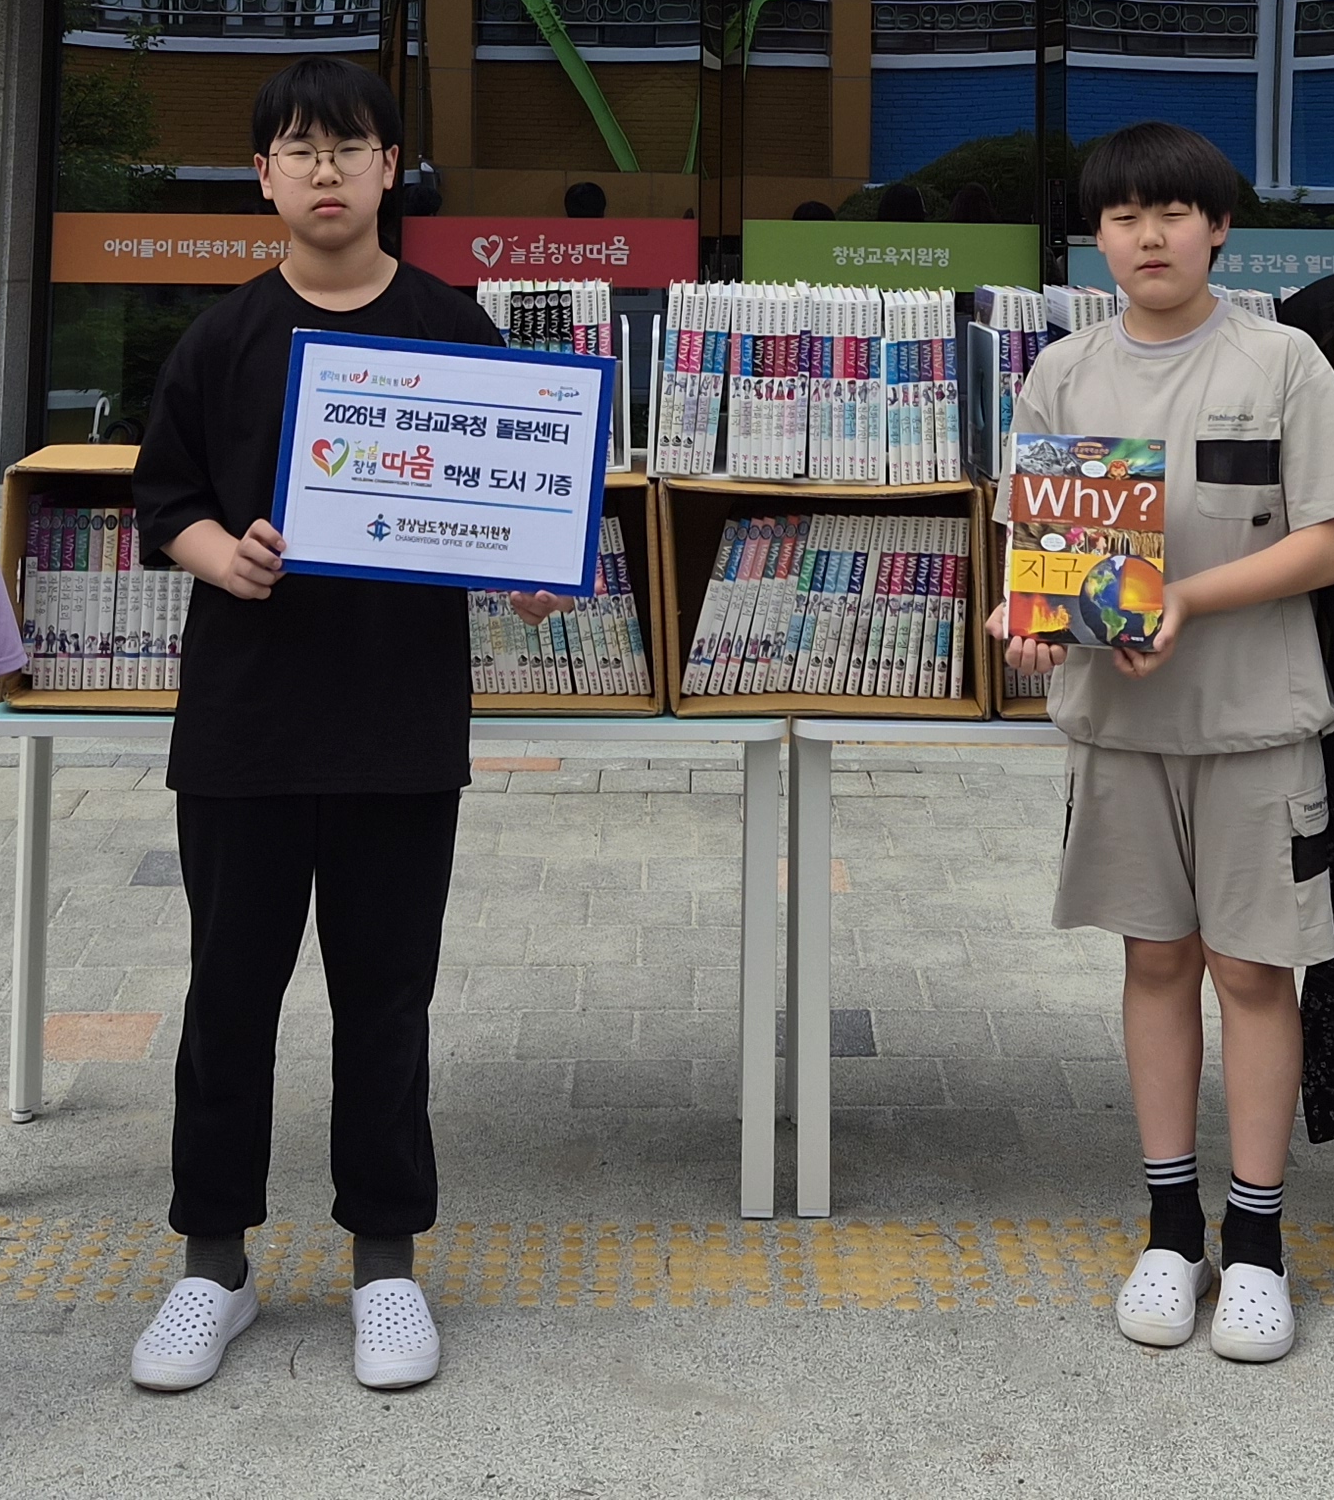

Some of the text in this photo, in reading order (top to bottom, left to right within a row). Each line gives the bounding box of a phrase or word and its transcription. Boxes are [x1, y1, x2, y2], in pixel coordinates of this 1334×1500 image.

[103, 238, 172, 258] 아이들이
[177, 239, 246, 259] 따뜻하게
[831, 244, 951, 269] 창녕교육지원청
[1249, 254, 1300, 274] 공간을
[536, 309, 547, 344] Why?
[664, 331, 677, 369] Why?
[677, 332, 689, 369] Why?
[688, 333, 702, 371] Why?
[701, 334, 714, 369] Why?
[741, 337, 753, 371] Why?
[752, 338, 765, 373] Why?
[765, 339, 775, 372] Why?
[787, 337, 798, 372] Why?
[798, 333, 810, 367] Why?
[811, 340, 822, 375] Why?
[858, 341, 868, 376] Why?
[921, 342, 932, 378] Why?
[944, 341, 955, 376] Why?
[1000, 333, 1012, 371] Why?
[323, 402, 570, 445] 2026년 경남교육청 돌봄센터
[671, 403, 684, 426] 물리
[352, 459, 378, 476] 창녕
[444, 464, 481, 488] 학생
[490, 469, 527, 493] 도서
[535, 472, 573, 497] 기증
[1023, 476, 1157, 526] Why?
[395, 534, 509, 551] CHANGNYEONG OFFICE OF EDUCATION
[396, 517, 511, 542] 경상남도창녕교육지원청
[76, 531, 88, 568] Why?
[104, 533, 116, 569] Why?
[120, 532, 131, 569] Why?
[713, 543, 732, 580] Why?
[764, 541, 781, 576] Why?
[776, 540, 793, 577] Why?
[616, 555, 632, 592] Why?
[798, 552, 816, 590] Why?
[824, 553, 841, 591] Why?
[837, 554, 853, 591] Why?
[849, 554, 866, 592] Why?
[878, 555, 893, 592] Why?
[892, 555, 906, 594] Why?
[904, 556, 918, 594] Why?
[917, 556, 930, 595] Why?
[929, 556, 943, 595] Why?
[943, 556, 956, 596] Why?
[1018, 554, 1083, 589] 지구
[59, 603, 70, 620] 요리
[100, 576, 113, 613] 세계 유산
[538, 622, 552, 648] 바다
[883, 624, 896, 649] 인체
